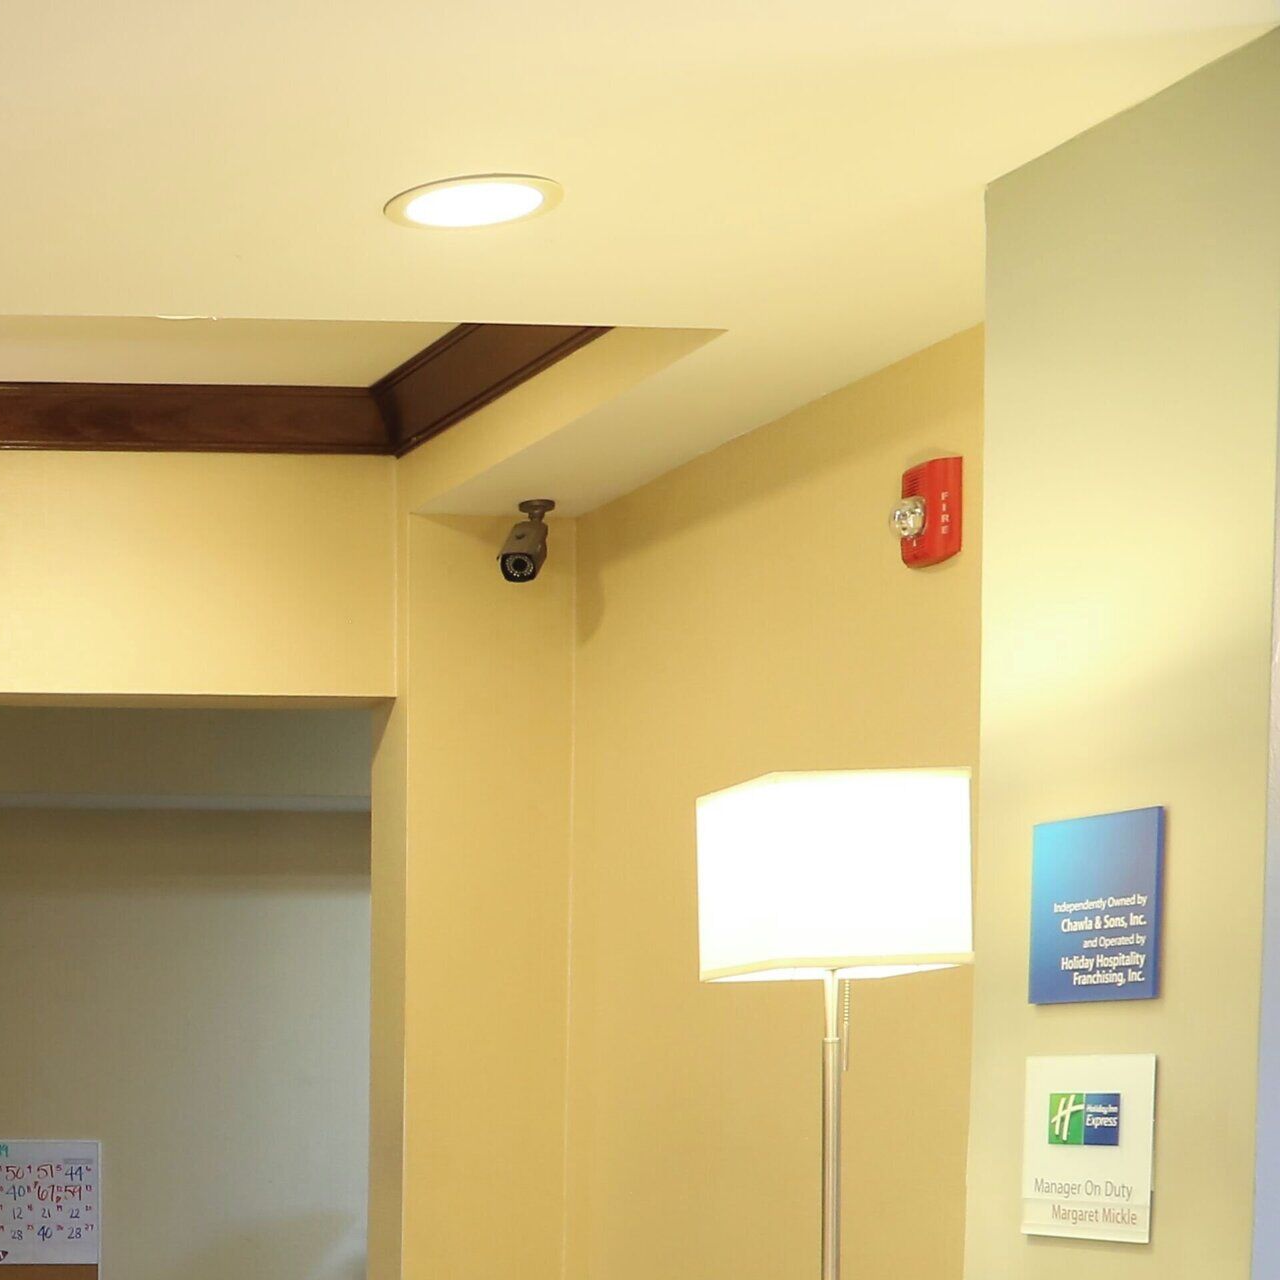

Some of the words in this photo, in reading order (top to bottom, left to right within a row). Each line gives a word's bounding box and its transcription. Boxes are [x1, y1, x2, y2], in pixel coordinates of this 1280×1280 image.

[940, 491, 950, 535] FIRE
[1053, 898, 1107, 914] Independently
[1108, 895, 1135, 908] Owned
[1137, 894, 1148, 906] by
[1061, 916, 1094, 933] Chawla
[1094, 915, 1102, 930] &
[1104, 915, 1128, 930] Sons,
[1130, 913, 1147, 926] Inc.
[1083, 936, 1098, 949] and
[1099, 934, 1136, 950] Operated
[1137, 933, 1146, 946] by
[1061, 954, 1094, 972] Holiday
[1096, 951, 1146, 970] Hospitality
[1073, 970, 1126, 987] Franchising,
[1128, 969, 1145, 982] Inc.
[1086, 1103, 1108, 1115] Holiday
[1085, 1114, 1118, 1128] Express
[64, 1165, 84, 1182] 44
[5, 1184, 26, 1201] 40
[1034, 1178, 1082, 1199] Manager
[1084, 1179, 1101, 1196] On
[1105, 1181, 1133, 1201] Duty
[1051, 1204, 1099, 1225] Margaret
[1102, 1207, 1138, 1226] Mickle
[37, 1225, 53, 1241] 40
